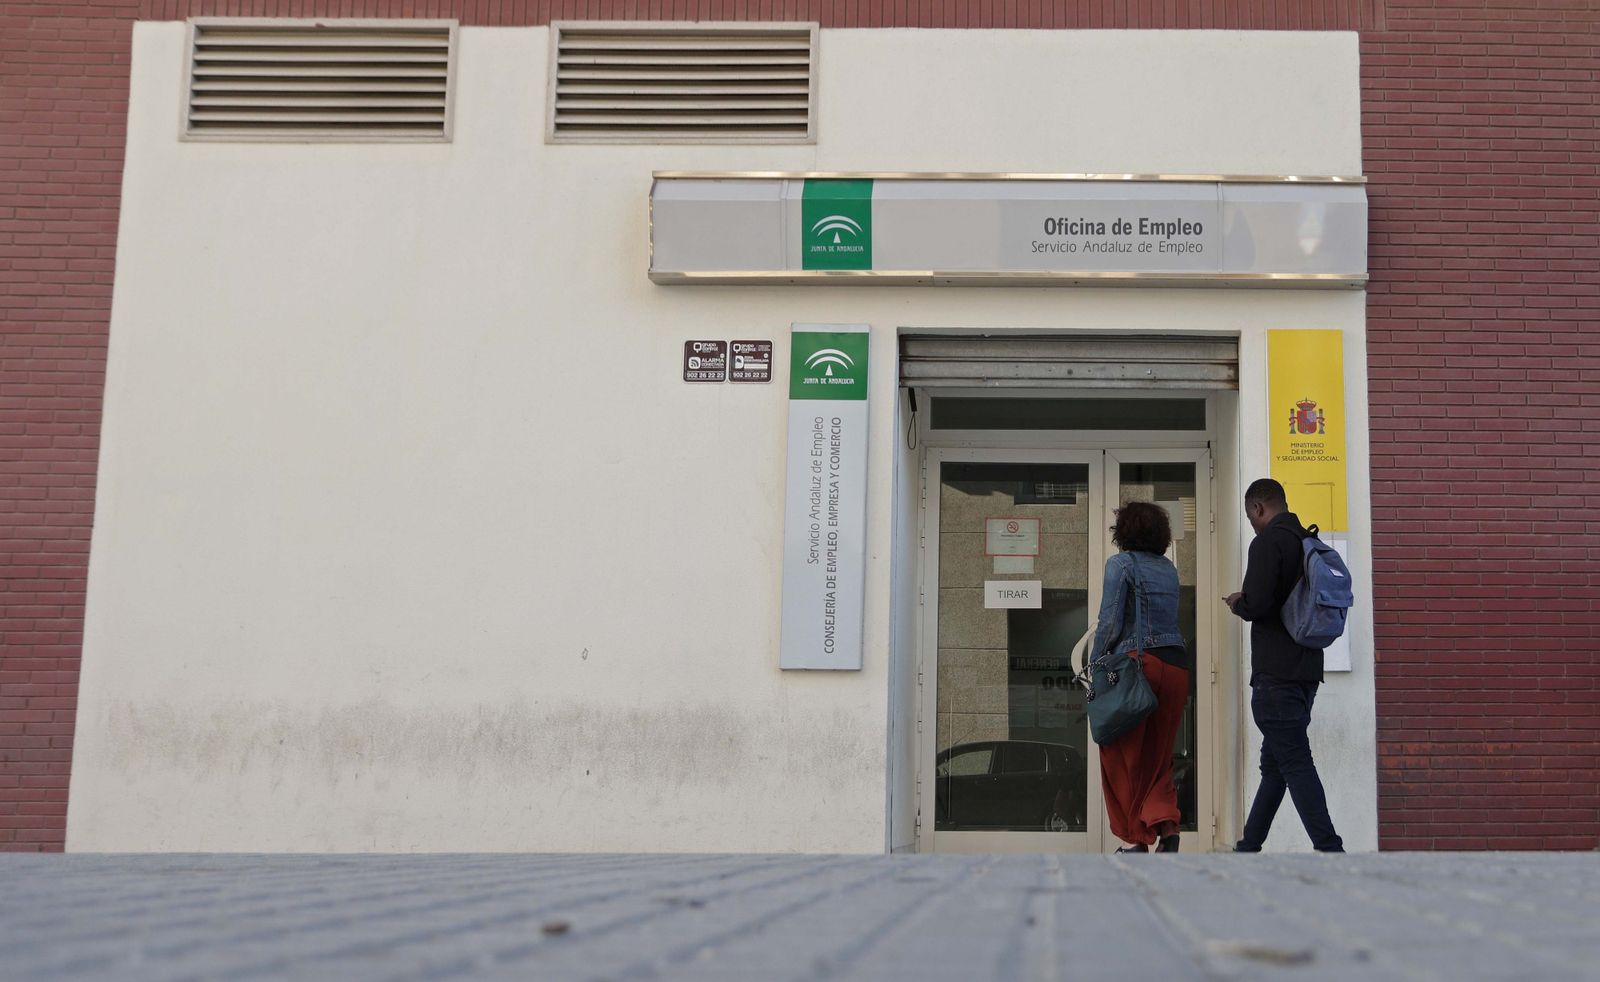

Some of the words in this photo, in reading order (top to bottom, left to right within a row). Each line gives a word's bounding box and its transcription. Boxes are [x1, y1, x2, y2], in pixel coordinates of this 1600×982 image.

[1044, 217, 1106, 236] Oficina
[1111, 217, 1133, 236] de
[1139, 217, 1204, 240] Empleo
[1031, 240, 1077, 253] Servicio
[1083, 240, 1133, 253] Andaluz
[1138, 240, 1153, 253] de
[1158, 240, 1204, 257] Empleo
[803, 377, 819, 385] JUNTA
[820, 377, 827, 385] DE
[811, 416, 827, 457] Empleo
[829, 416, 842, 469] COMERCIO
[810, 459, 823, 474] de
[829, 470, 840, 479] Y
[809, 475, 822, 521] Andaluz
[828, 480, 840, 526] EMPRESA
[807, 523, 821, 566] Servicio
[826, 530, 840, 573] EMPLEO,
[825, 575, 838, 590] DE
[997, 589, 1030, 600] TIRAR
[823, 591, 837, 655] CONSEJERÍA
